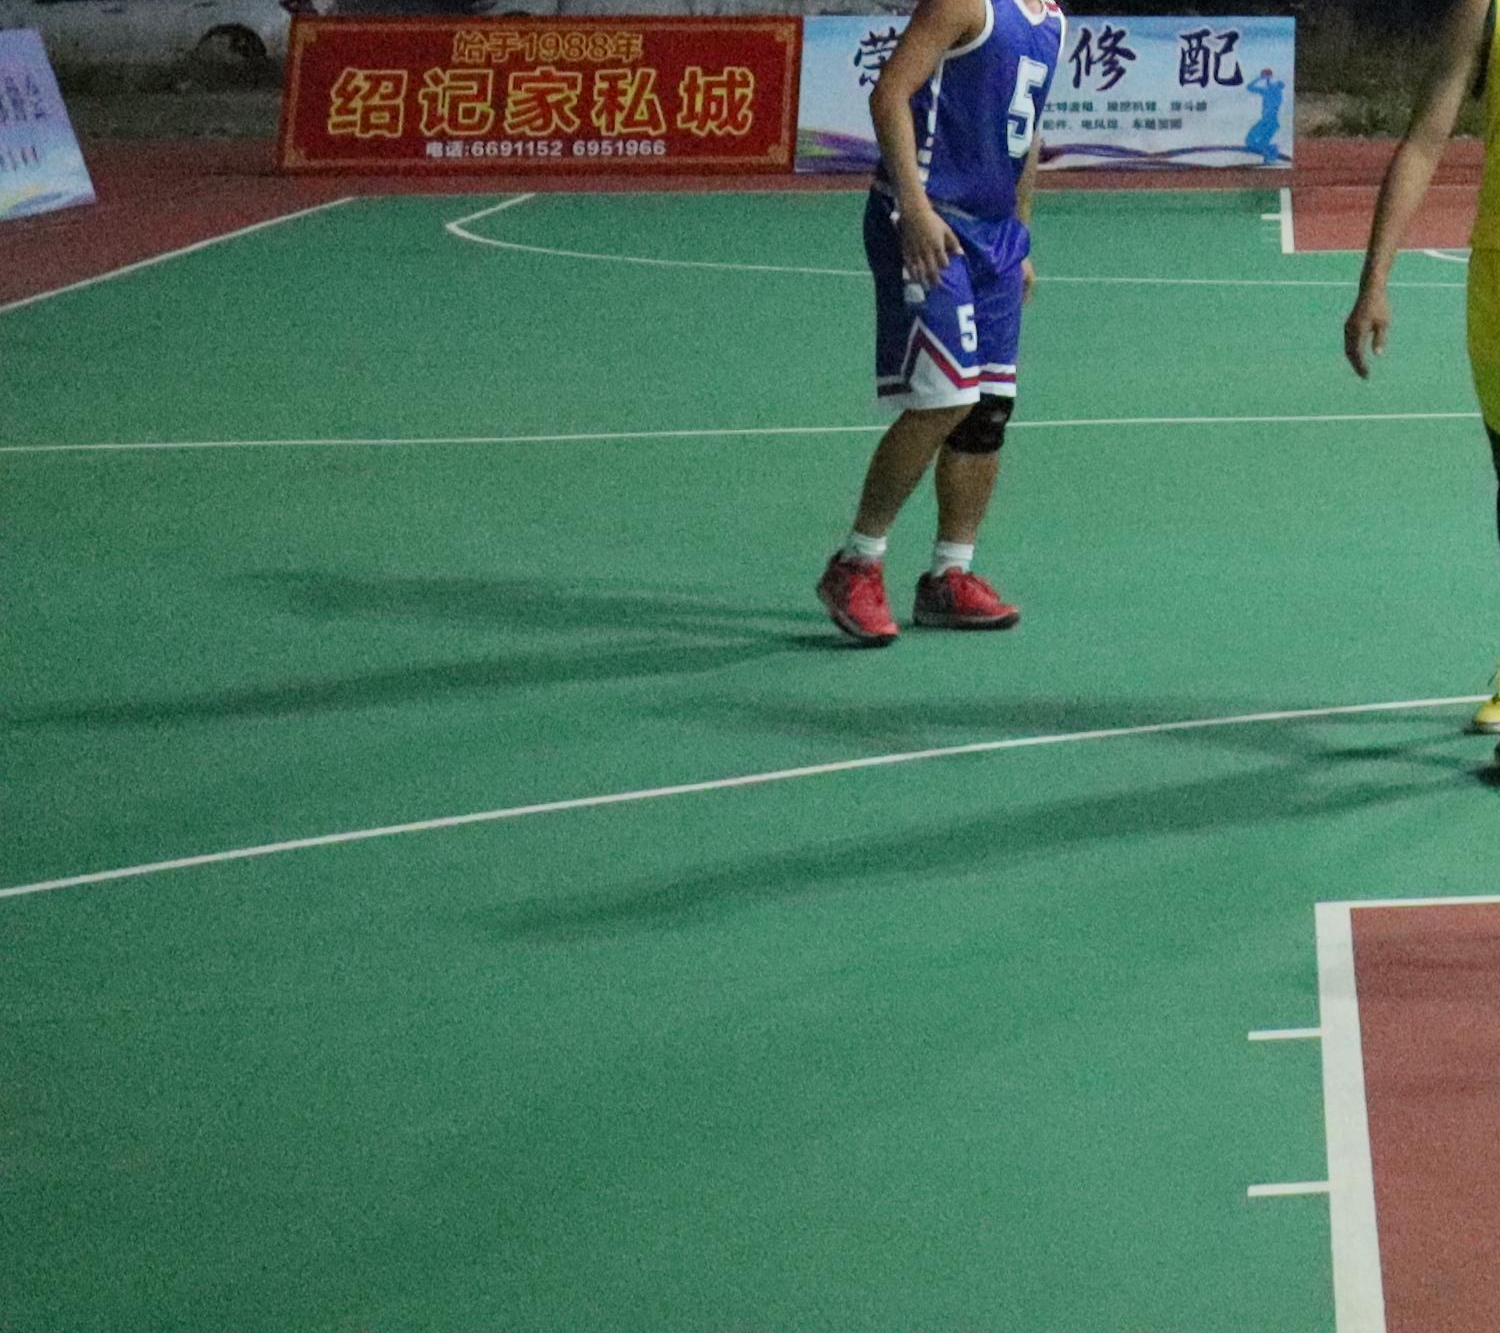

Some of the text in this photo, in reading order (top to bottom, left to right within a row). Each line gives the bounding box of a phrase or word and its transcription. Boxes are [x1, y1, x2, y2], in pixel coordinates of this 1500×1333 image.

[452, 31, 643, 63] 始于1988年
[328, 66, 755, 138] 绍记家私城
[1006, 55, 1048, 159] 5
[572, 139, 667, 157] 6951966
[956, 302, 978, 353] 5
